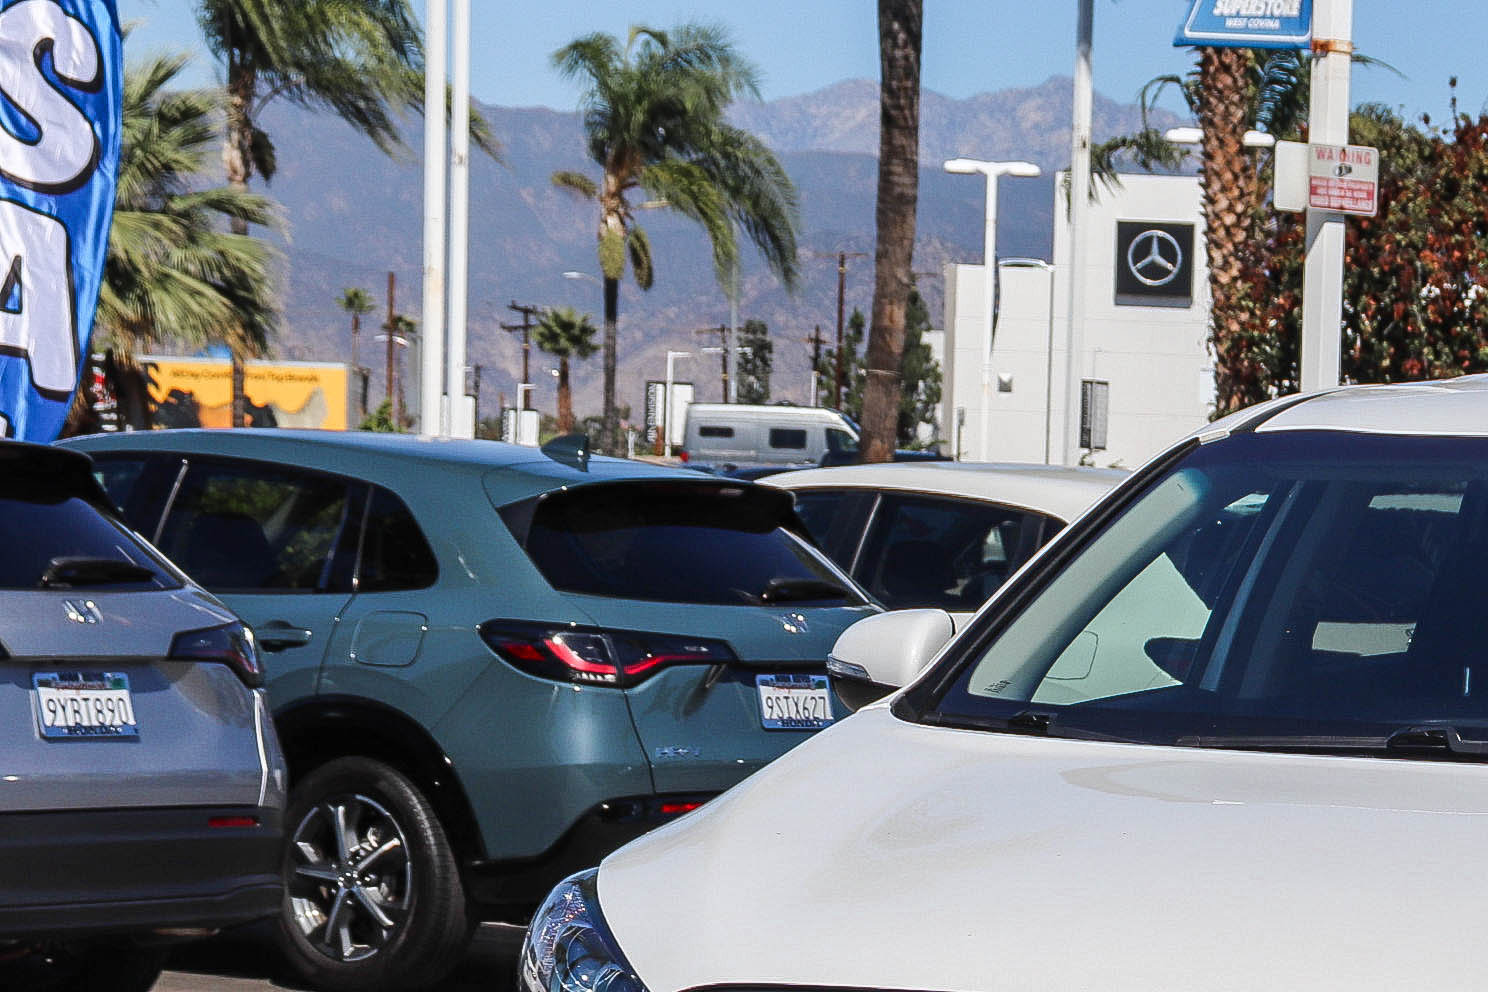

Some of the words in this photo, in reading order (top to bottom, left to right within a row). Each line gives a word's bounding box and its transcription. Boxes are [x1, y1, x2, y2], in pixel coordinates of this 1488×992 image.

[1248, 18, 1281, 30] COVINA
[46, 697, 129, 726] 9YBT890
[765, 696, 827, 720] 9STX627
